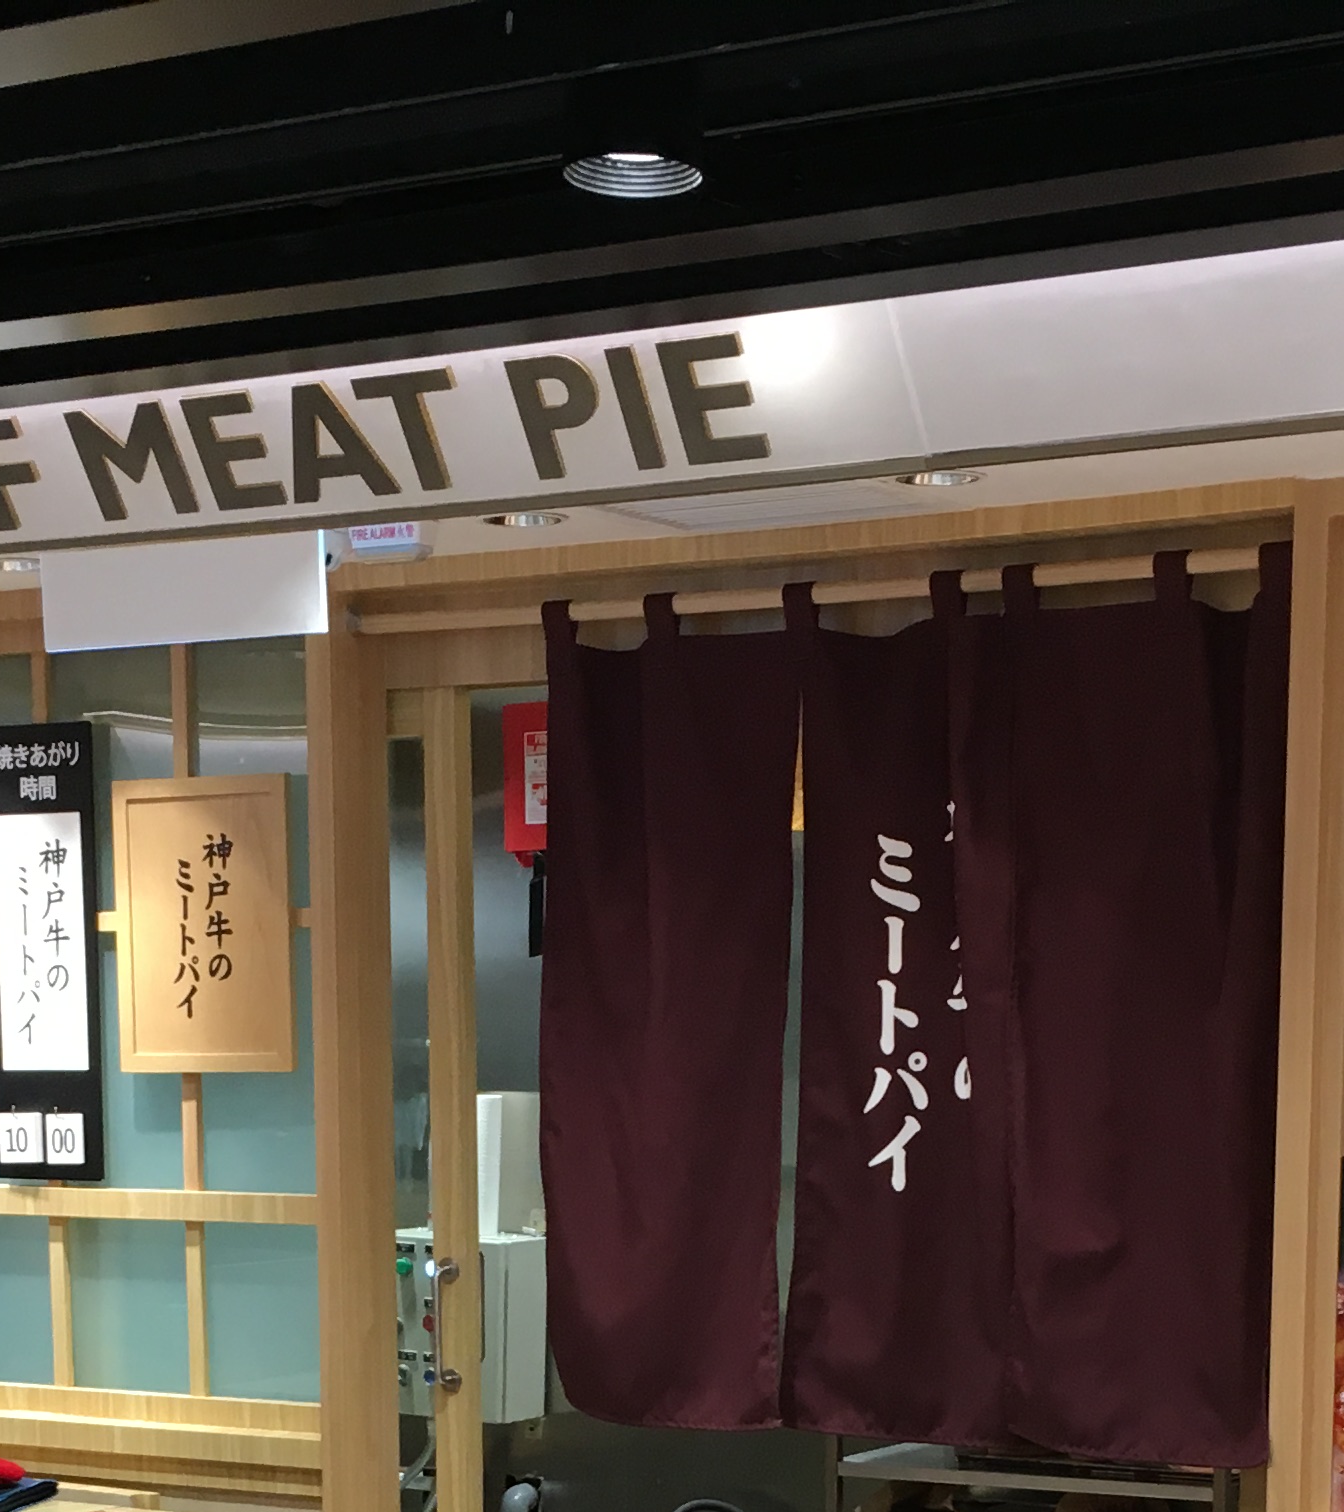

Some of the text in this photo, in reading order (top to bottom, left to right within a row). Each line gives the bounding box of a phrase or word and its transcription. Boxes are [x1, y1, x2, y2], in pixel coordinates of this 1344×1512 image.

[63, 365, 456, 521] MEAT
[504, 331, 771, 480] PIE
[19, 775, 56, 801] 時間
[17, 867, 41, 1045] ミートパイ
[173, 859, 200, 1018] ミートパイ
[863, 834, 929, 1192] ミートパイ
[5, 1127, 76, 1153] 10 00
